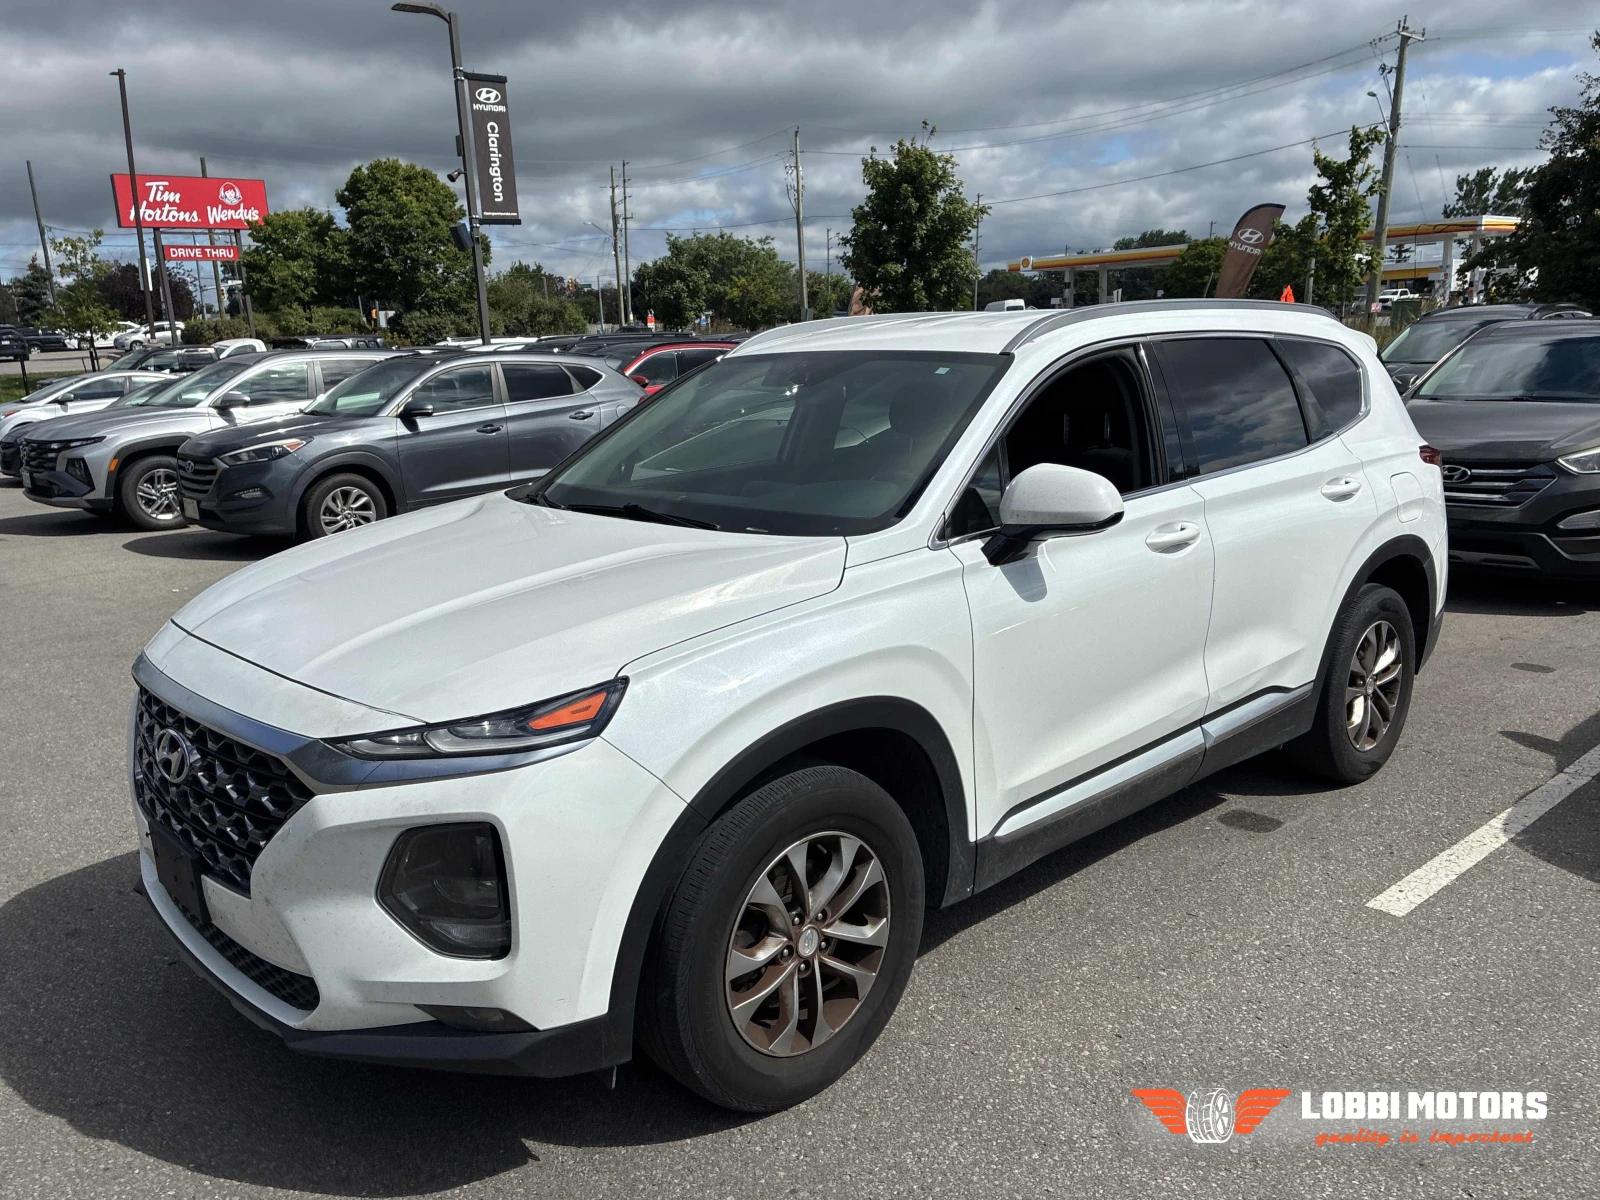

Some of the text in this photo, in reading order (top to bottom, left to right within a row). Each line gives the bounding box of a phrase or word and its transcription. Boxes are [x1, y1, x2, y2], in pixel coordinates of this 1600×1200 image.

[473, 103, 506, 112] HYUNDAI
[486, 121, 504, 202] Clarington
[145, 181, 181, 204] Tim
[206, 203, 260, 225] Wendy's
[169, 248, 234, 258] DRIVE THRU
